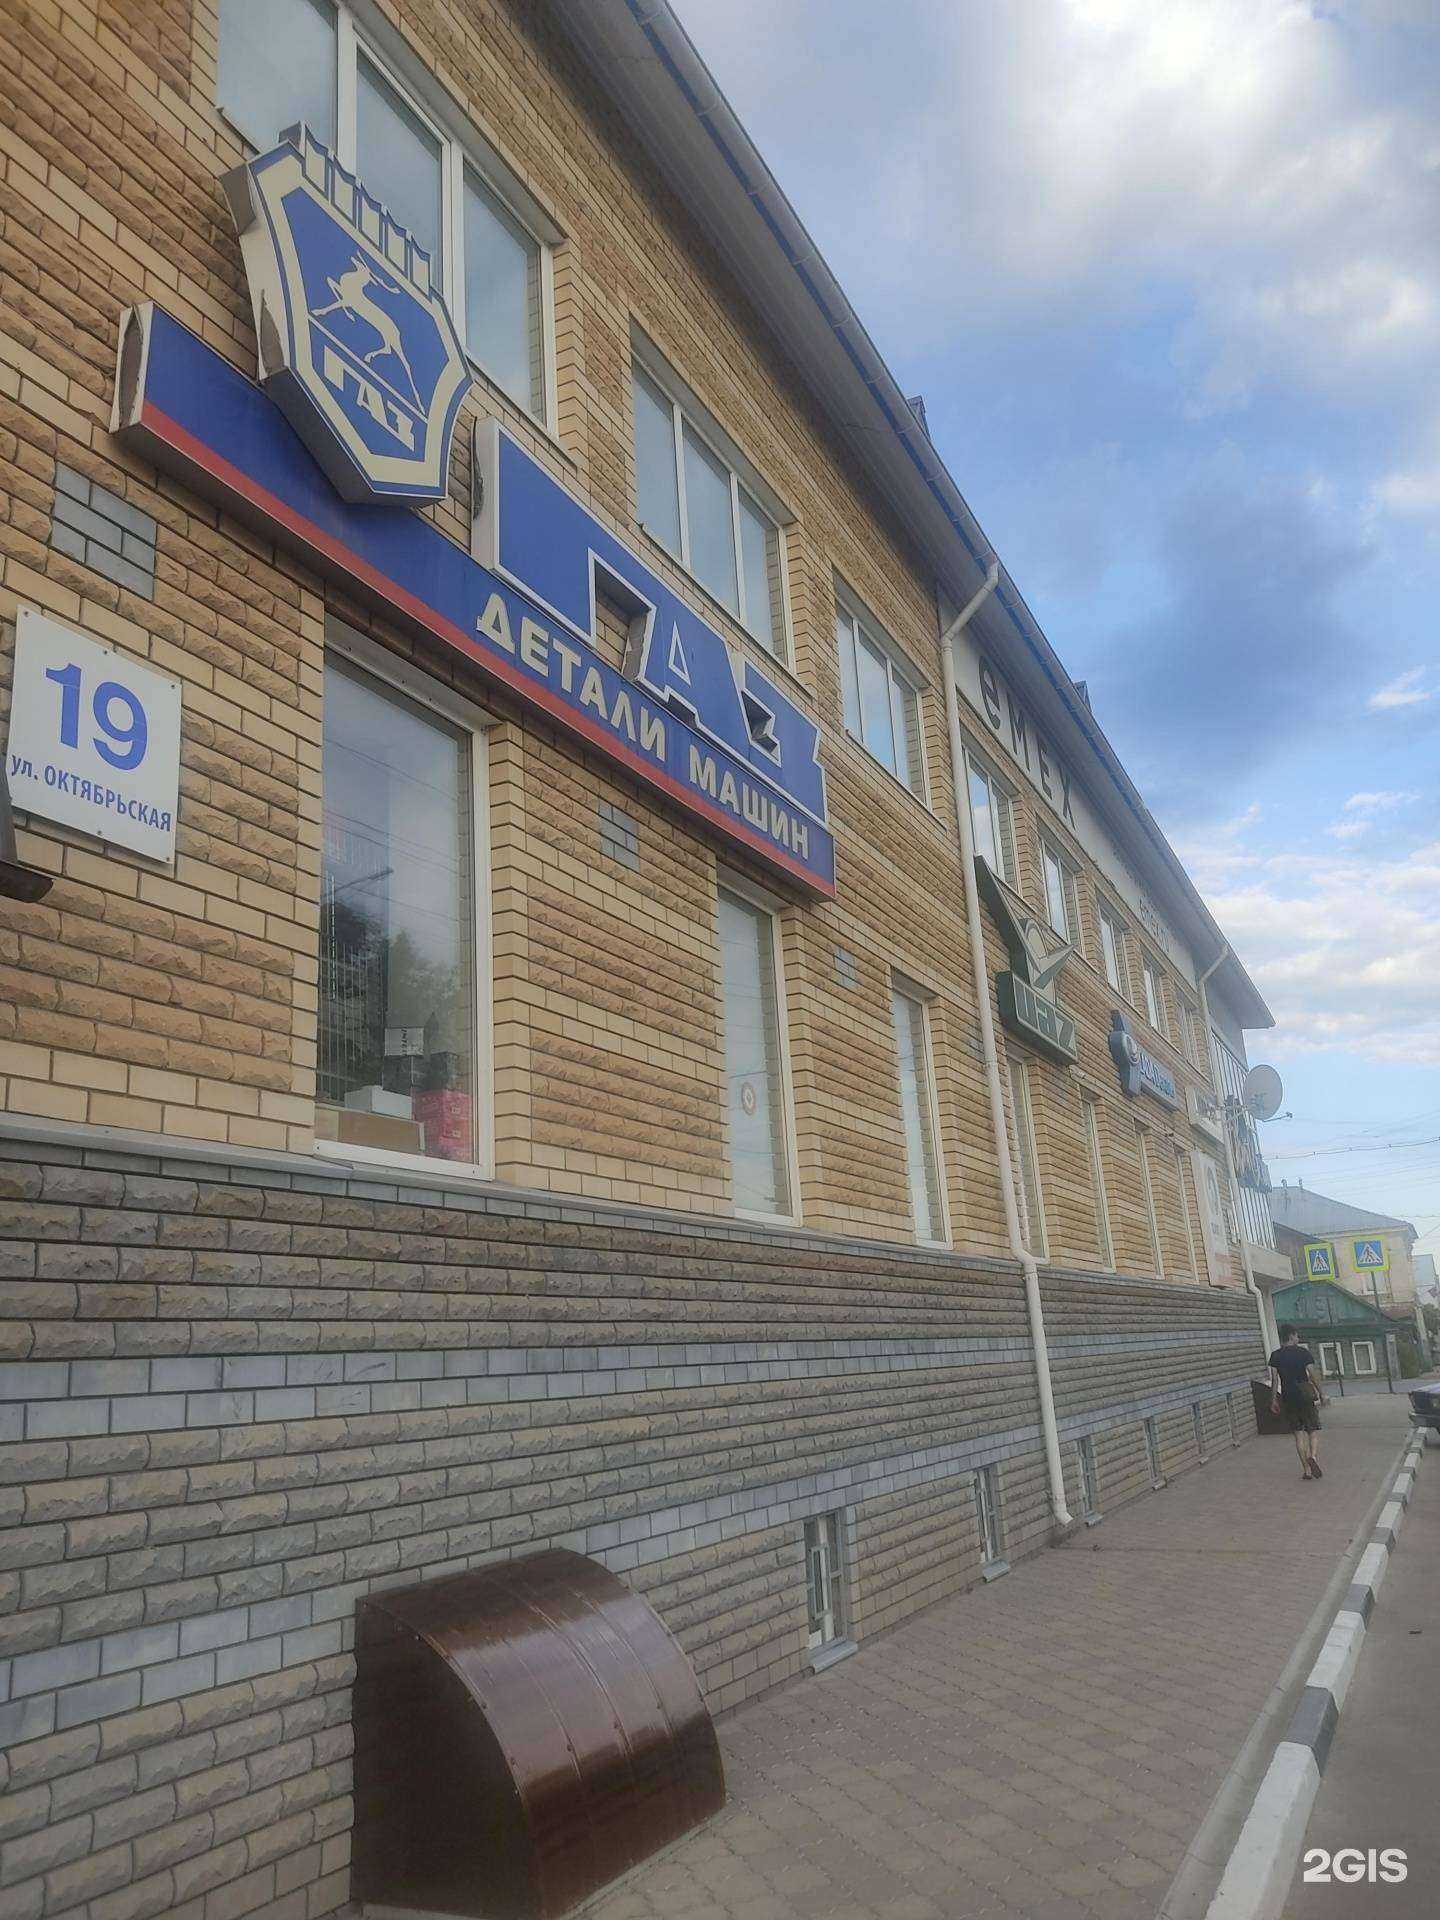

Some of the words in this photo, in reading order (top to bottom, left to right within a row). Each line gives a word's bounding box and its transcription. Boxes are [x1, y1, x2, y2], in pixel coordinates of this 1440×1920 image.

[323, 345, 415, 452] ГАЗ
[45, 662, 148, 771] 19
[476, 592, 666, 762] ДЕТАЛИ
[688, 744, 811, 860] МАШИН
[11, 754, 38, 781] ул.
[44, 764, 172, 832] ОКТЯБРЬСКАЯ
